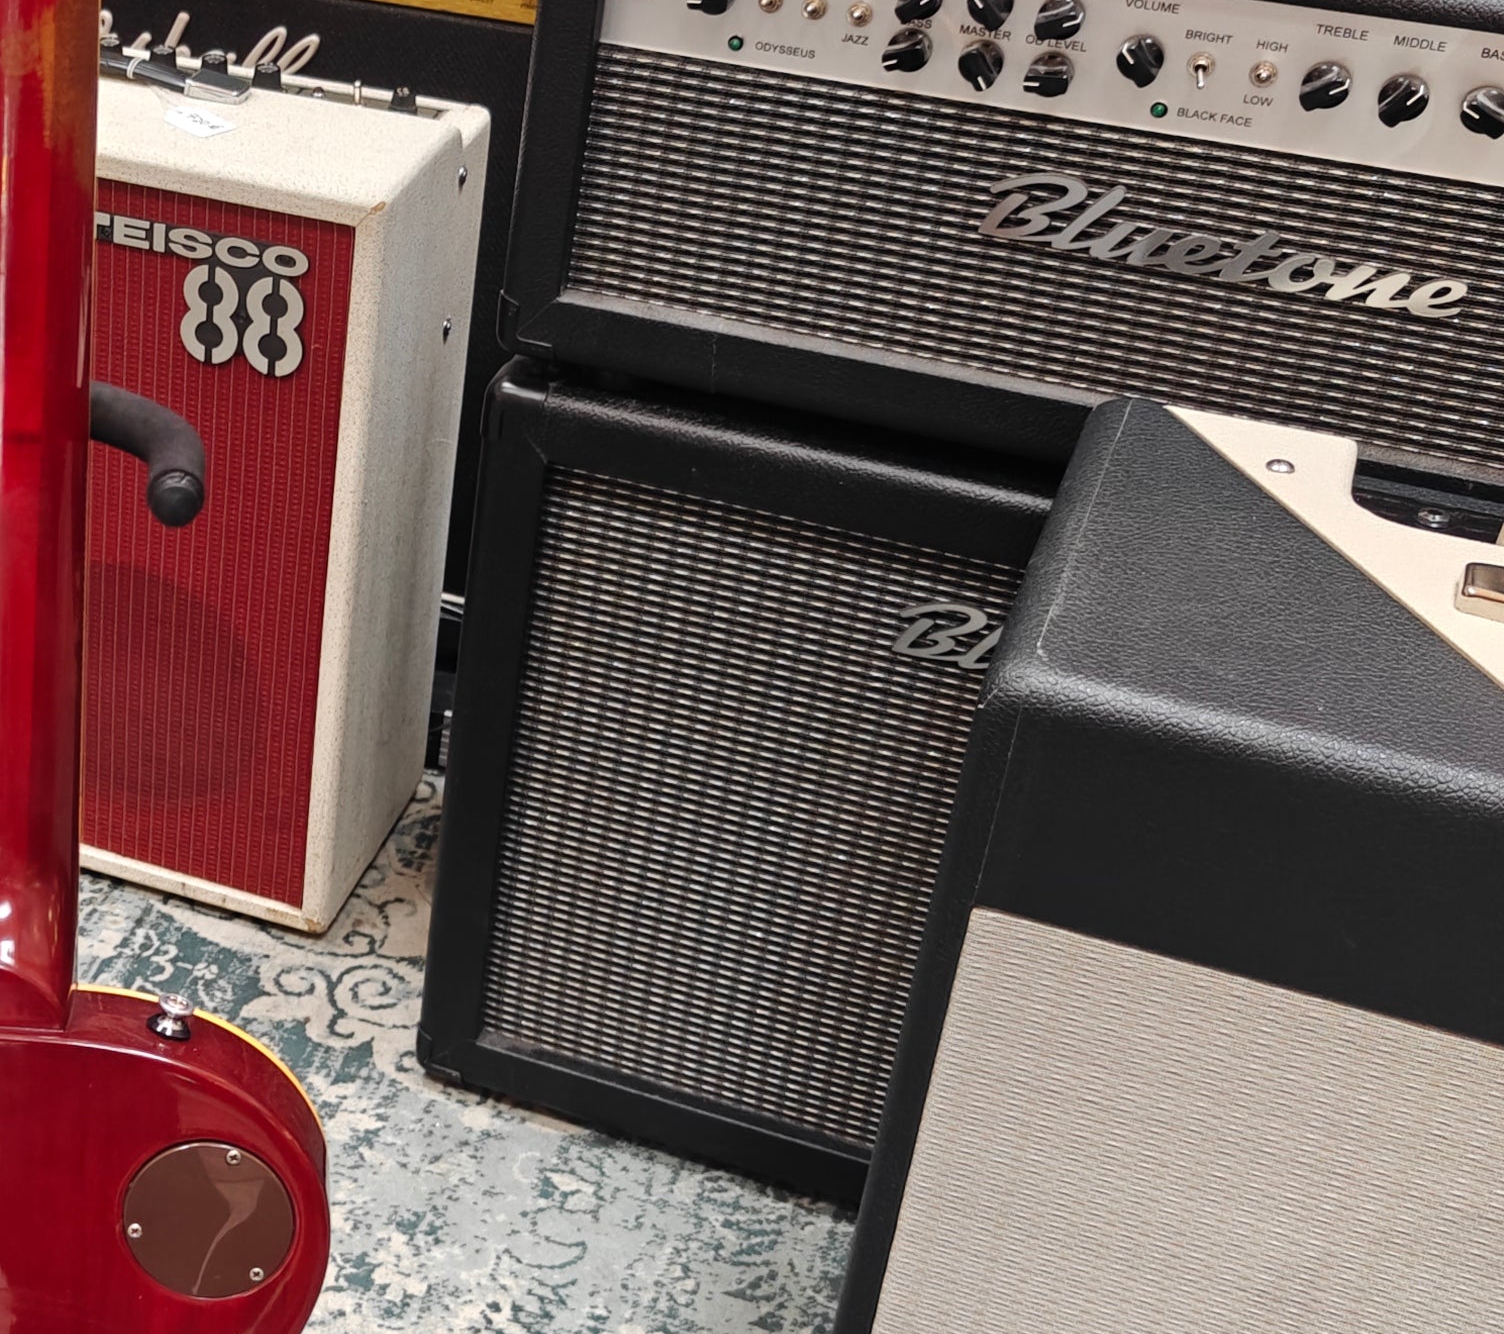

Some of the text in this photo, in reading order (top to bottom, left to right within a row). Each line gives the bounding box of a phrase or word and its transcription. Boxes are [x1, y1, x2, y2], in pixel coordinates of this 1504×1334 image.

[901, 18, 932, 29] ASS
[841, 33, 869, 46] JAZZ
[959, 24, 1012, 41] MASTER
[1185, 29, 1234, 45] BRIGHT
[1316, 23, 1369, 41] TREBLE
[755, 41, 816, 60] ODYSSEUS
[1047, 39, 1087, 53] LEVEL
[1256, 40, 1289, 53] HIGH
[1393, 35, 1448, 52] MIDDLE
[1480, 47, 1504, 61] BAS
[1243, 94, 1274, 107] LOW
[1176, 107, 1253, 127] BLACK FACE
[977, 172, 1469, 318] Bluetone
[179, 264, 305, 378] 88
